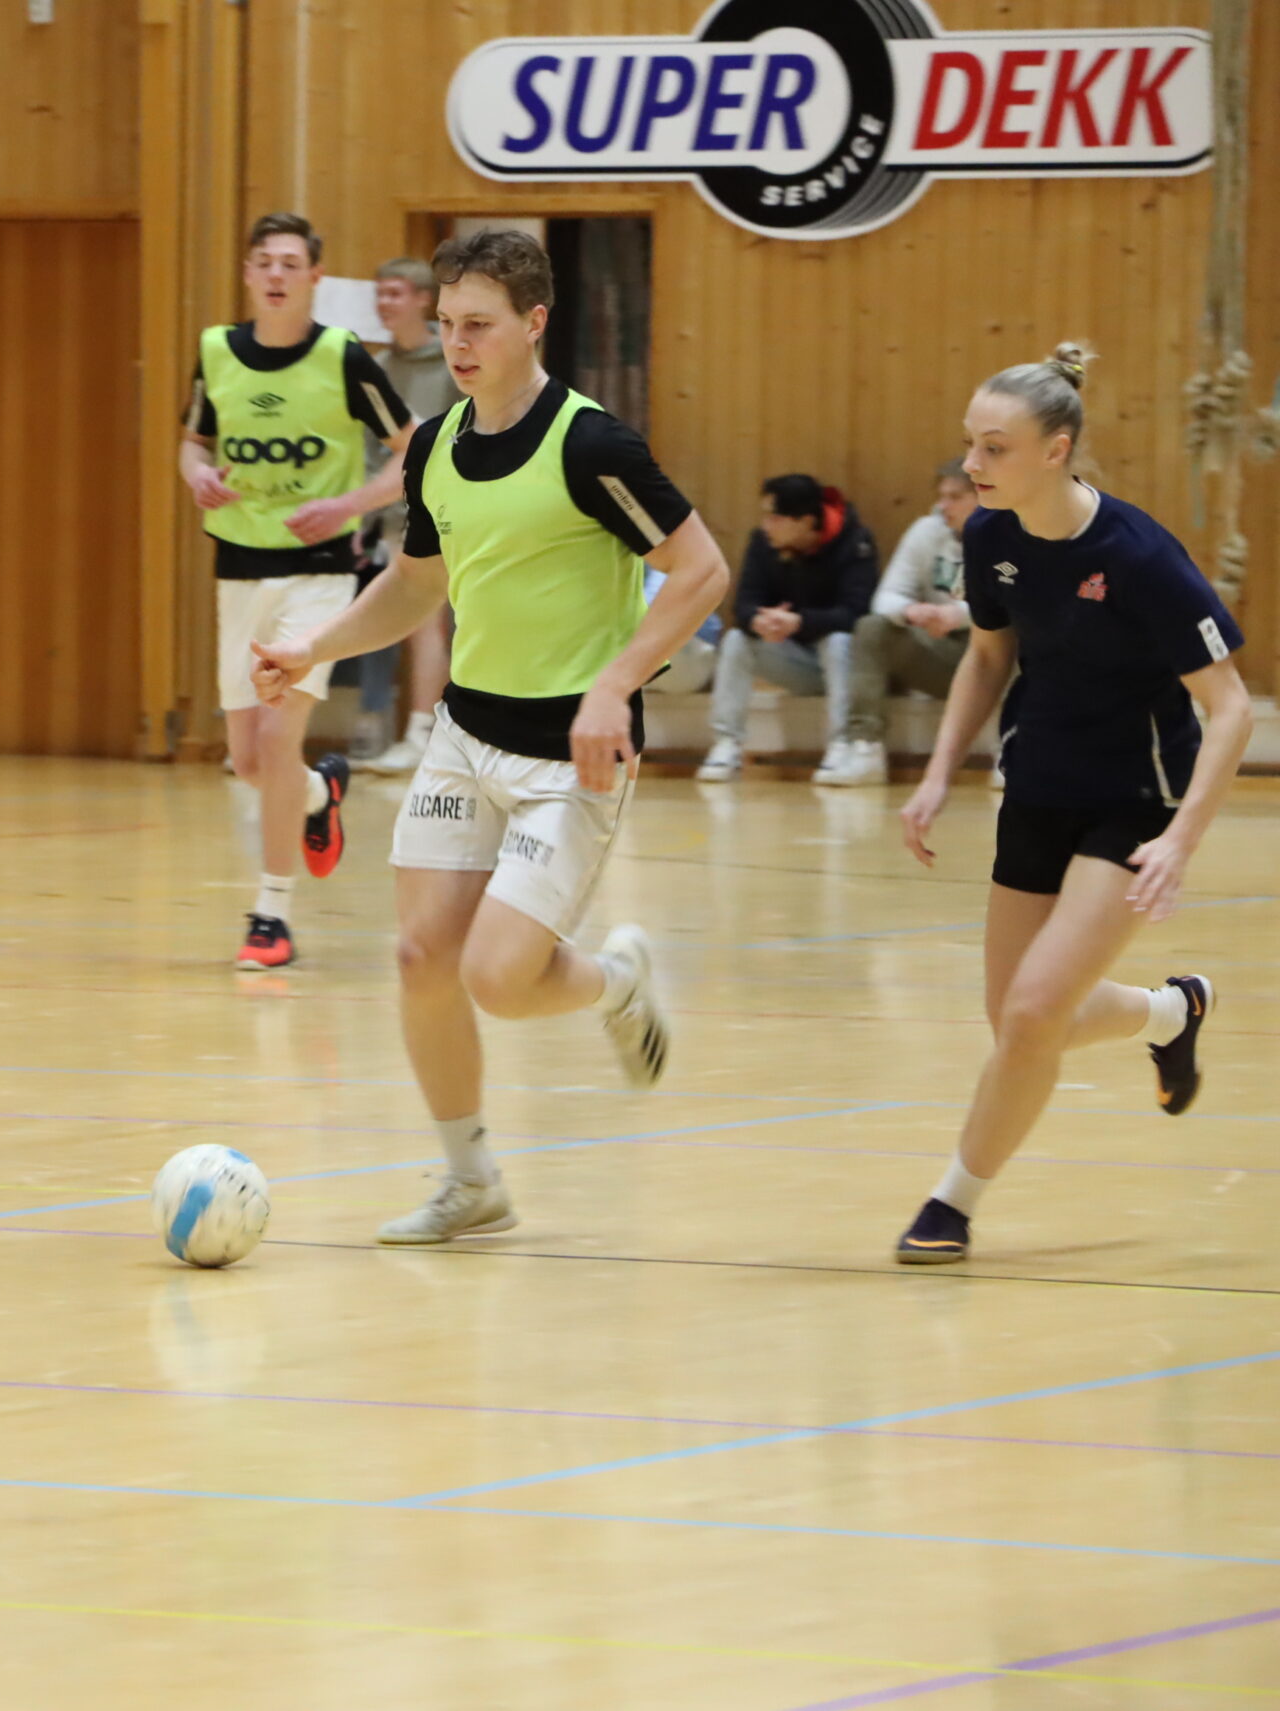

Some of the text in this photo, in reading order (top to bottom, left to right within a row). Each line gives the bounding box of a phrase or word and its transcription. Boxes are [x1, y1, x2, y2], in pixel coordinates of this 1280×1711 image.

[500, 46, 1195, 154] SUPER DEKK
[759, 112, 886, 207] SERVICE
[223, 435, 326, 469] coop
